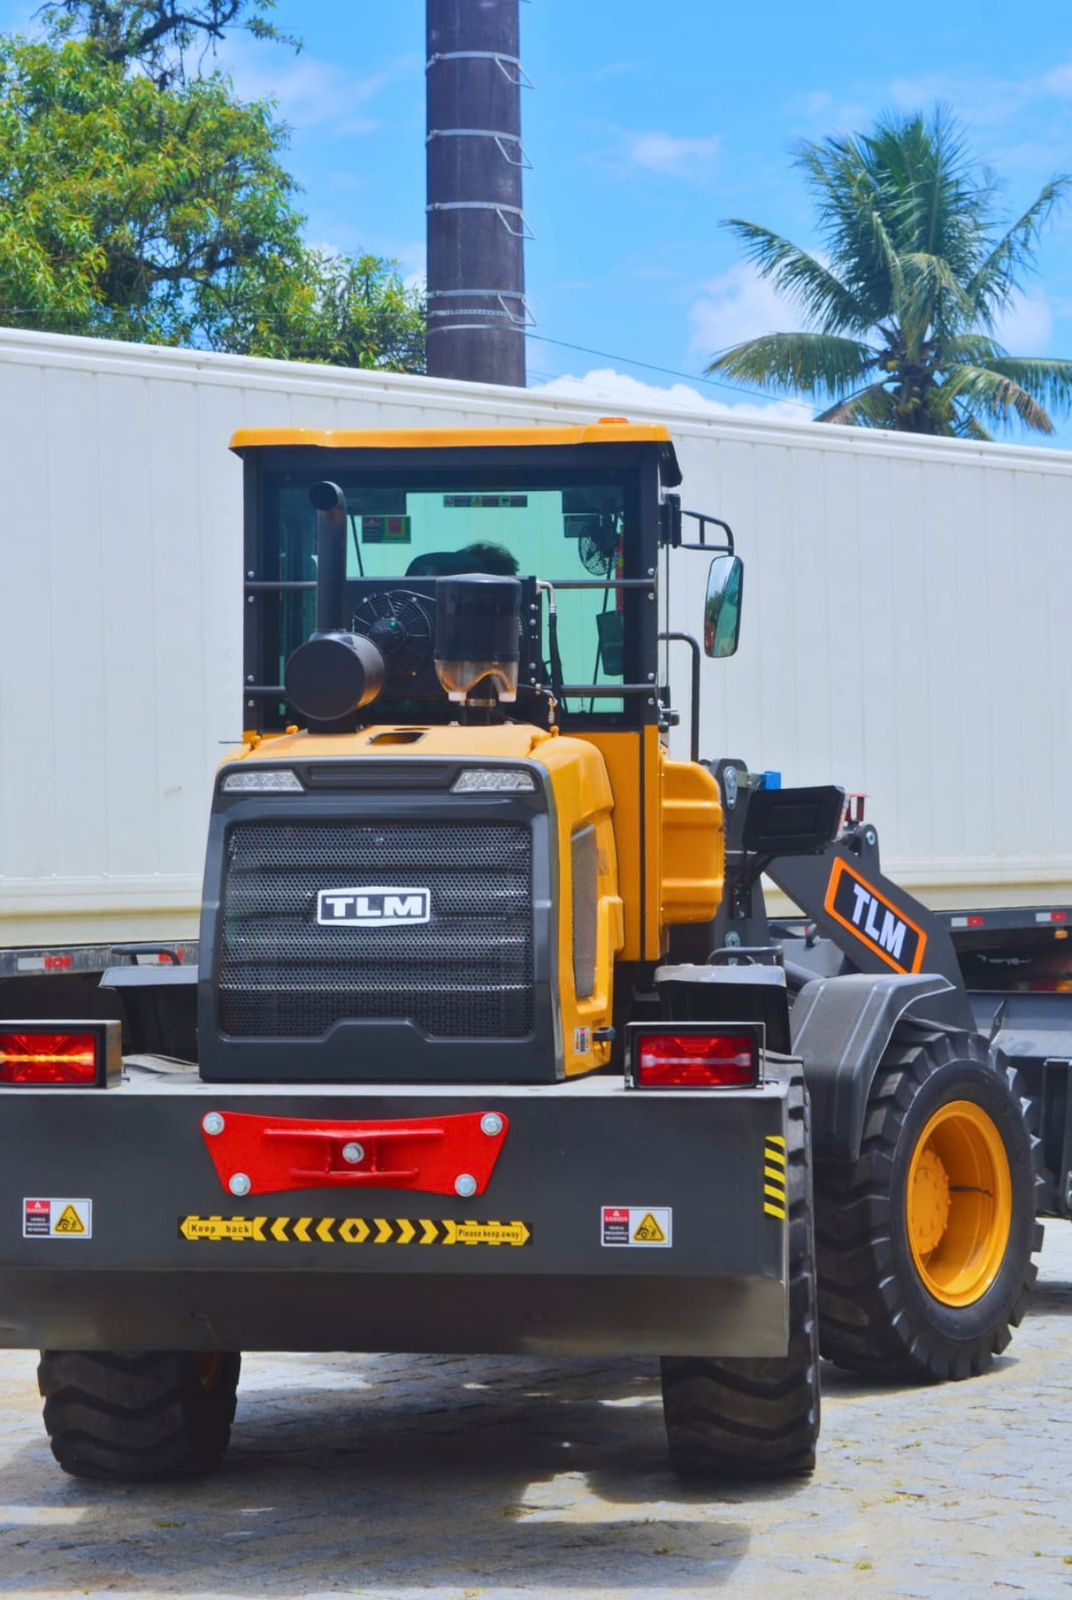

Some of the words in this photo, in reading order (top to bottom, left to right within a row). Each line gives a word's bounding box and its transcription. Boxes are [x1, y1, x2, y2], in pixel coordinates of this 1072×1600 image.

[325, 896, 422, 917] TLM
[852, 882, 907, 960] TLM
[191, 1223, 216, 1234] Keep
[226, 1224, 249, 1233] back
[458, 1226, 481, 1238] Please
[482, 1227, 500, 1239] keep
[501, 1230, 520, 1240] away
